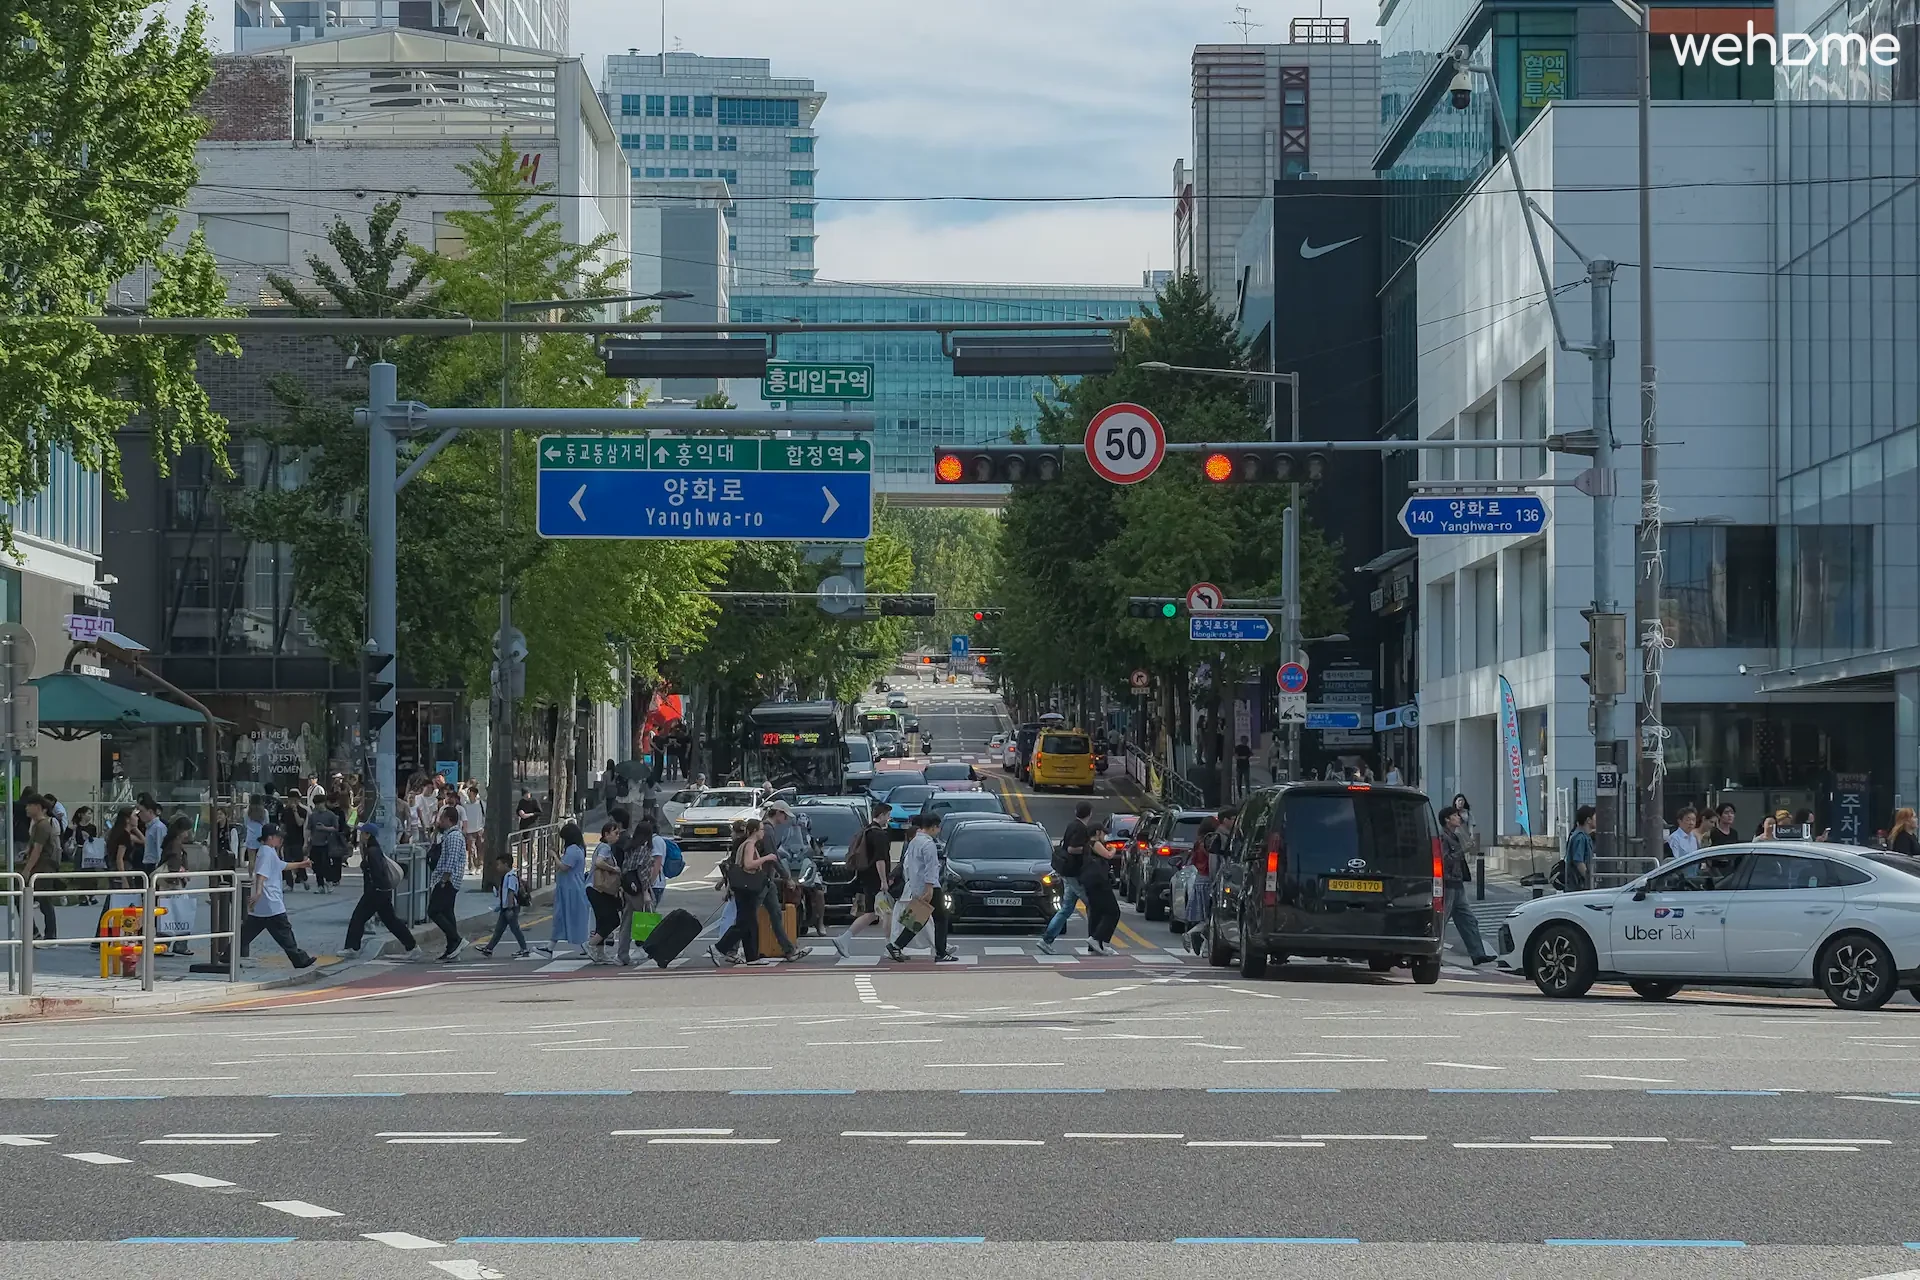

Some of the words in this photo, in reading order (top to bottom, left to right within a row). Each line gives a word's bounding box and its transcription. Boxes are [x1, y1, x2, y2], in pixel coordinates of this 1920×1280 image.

[1524, 55, 1564, 78] 혈액
[1523, 81, 1564, 104] 투석
[767, 369, 868, 394] 홍대입구역
[565, 443, 645, 465] 동교동삼거리
[1105, 426, 1147, 460] 50
[675, 443, 734, 467] 홍익대
[786, 445, 845, 467] 합정역
[664, 478, 745, 506] 양화로
[645, 507, 764, 530] Yanghwa-ro
[1411, 510, 1434, 524] 140
[1449, 500, 1503, 519] 양화로
[1516, 509, 1539, 522] 136
[1440, 520, 1513, 534] Yanghwa-ro
[268, 730, 288, 739] MEN
[268, 765, 303, 774] WOMEN
[1600, 773, 1613, 784] 33
[1624, 925, 1664, 941] Uber
[1667, 924, 1695, 940] Taxi
